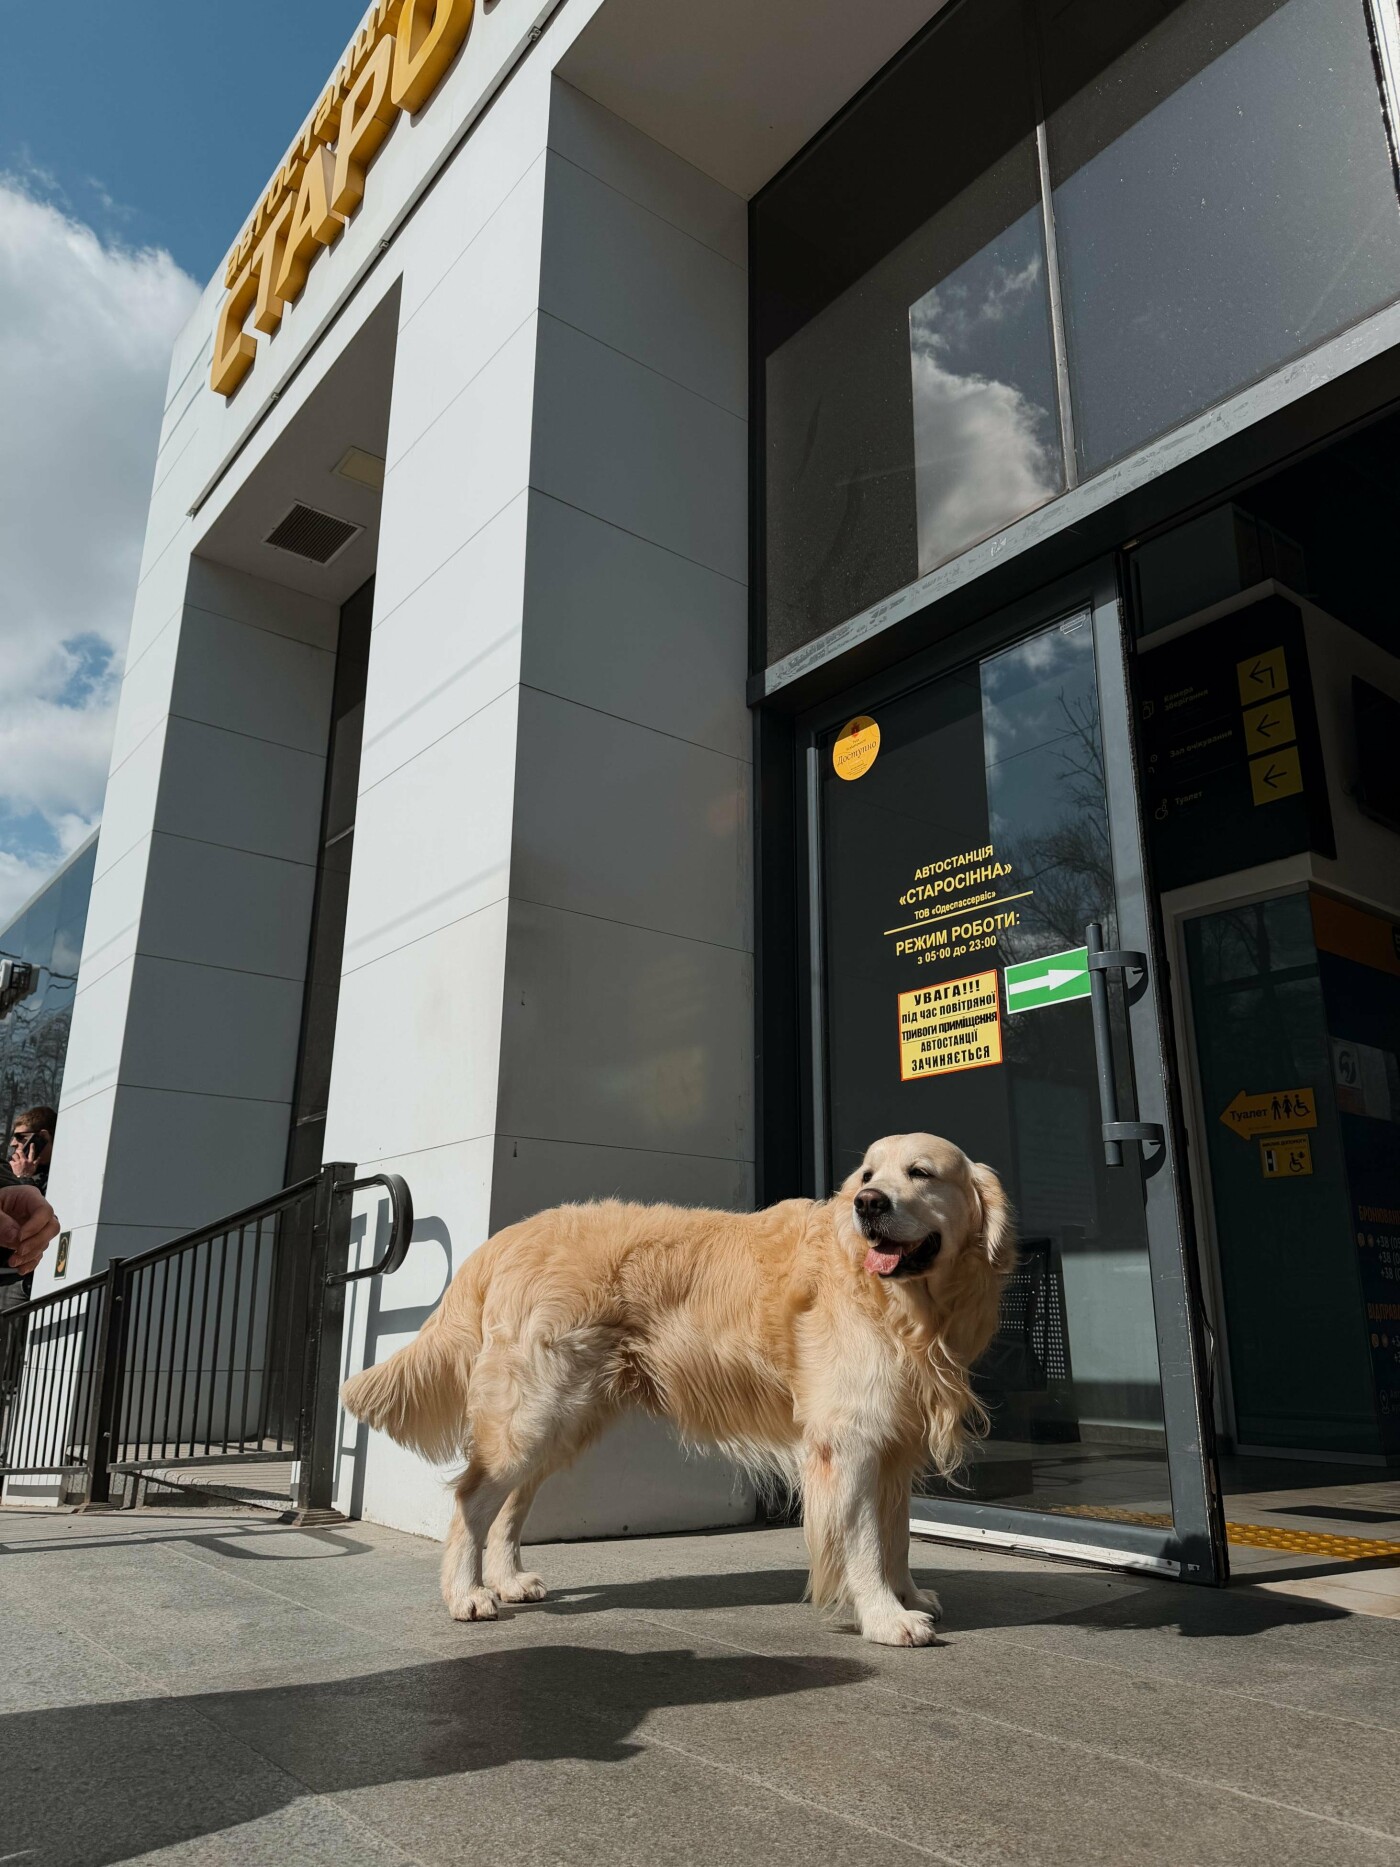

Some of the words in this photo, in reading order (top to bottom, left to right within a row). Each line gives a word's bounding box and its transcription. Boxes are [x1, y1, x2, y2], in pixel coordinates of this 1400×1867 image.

[210, 0, 480, 398] СТАРО
[837, 741, 877, 767] Доступно
[1174, 790, 1203, 806] Туалет
[914, 845, 994, 881] АВТОСТАНЦІЯ
[899, 862, 1012, 906] «СТАРОСІННА»
[914, 908, 929, 920] ТОВ
[931, 891, 996, 915] «Одеспассервіс»
[896, 929, 947, 957] РЕЖИМ
[951, 911, 1020, 942] РОБОТИ:
[917, 956, 923, 965] з
[953, 945, 967, 958] до
[969, 935, 997, 952] 23:00
[902, 1011, 918, 1024] під
[920, 1007, 937, 1020] час
[939, 991, 996, 1016] повітряної
[914, 979, 980, 1007] УВАГА!!!
[902, 1024, 937, 1042] тривоги
[938, 1011, 998, 1034] приміщення
[920, 1028, 978, 1053] АВТОСТАНЦІЇ
[911, 1045, 990, 1072] ЗАЧИНЯЄТЬСЯ
[1229, 1108, 1268, 1122] Туалет
